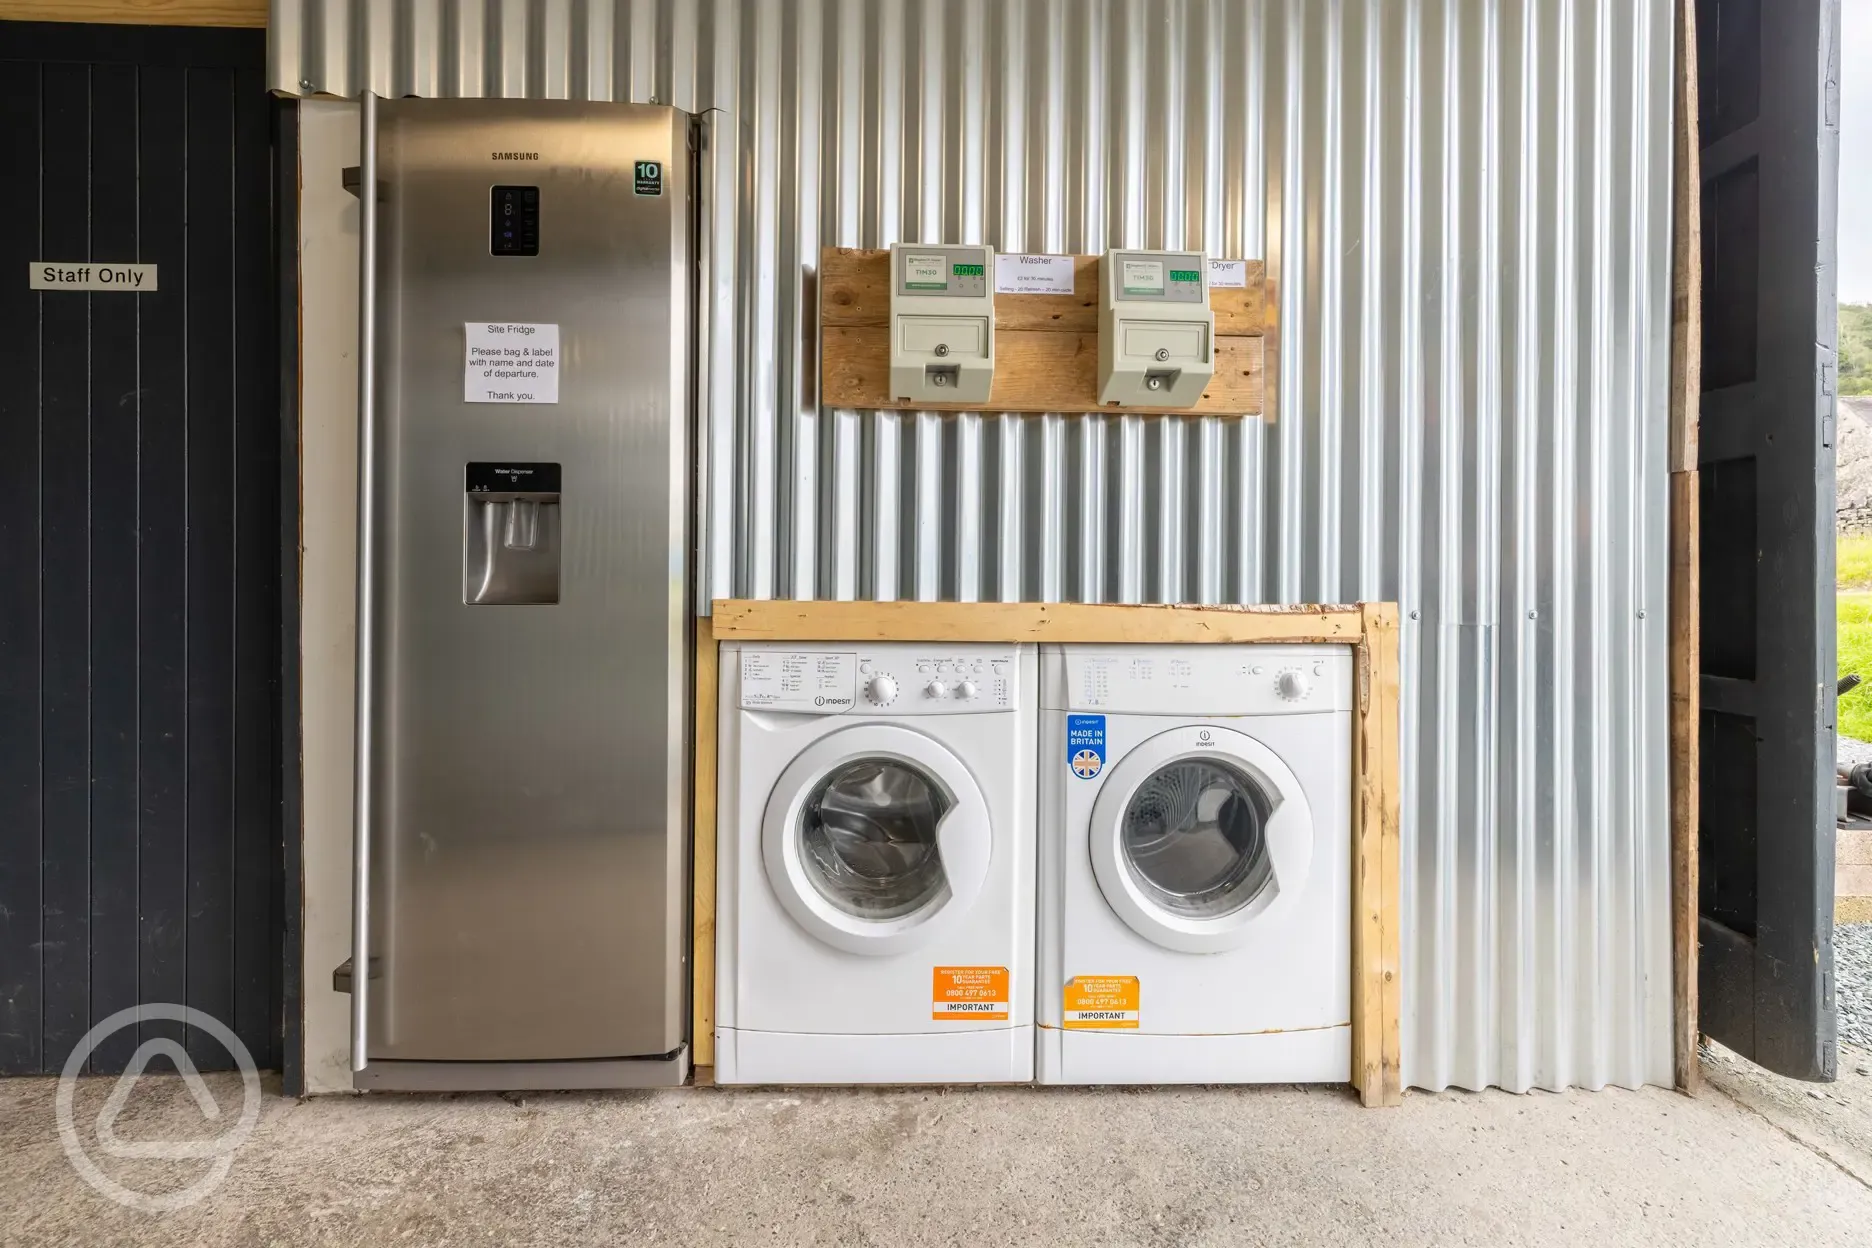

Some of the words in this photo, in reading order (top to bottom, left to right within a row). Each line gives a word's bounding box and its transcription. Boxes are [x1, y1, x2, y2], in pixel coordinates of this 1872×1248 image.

[491, 152, 539, 160] SAMSUNG
[638, 164, 658, 178] 10
[1020, 256, 1052, 264] Washer
[1212, 262, 1235, 271] Dryer
[43, 267, 90, 282] Staff
[98, 268, 144, 286] Only
[488, 324, 505, 334] Site
[507, 325, 536, 335] Fridge
[471, 347, 502, 356] Please
[504, 348, 520, 357] bag
[483, 369, 492, 377] of
[494, 370, 539, 379] departure.
[487, 391, 514, 400] Thank
[517, 393, 536, 401] you.
[952, 975, 962, 984] 10
[1084, 984, 1093, 992] 10
